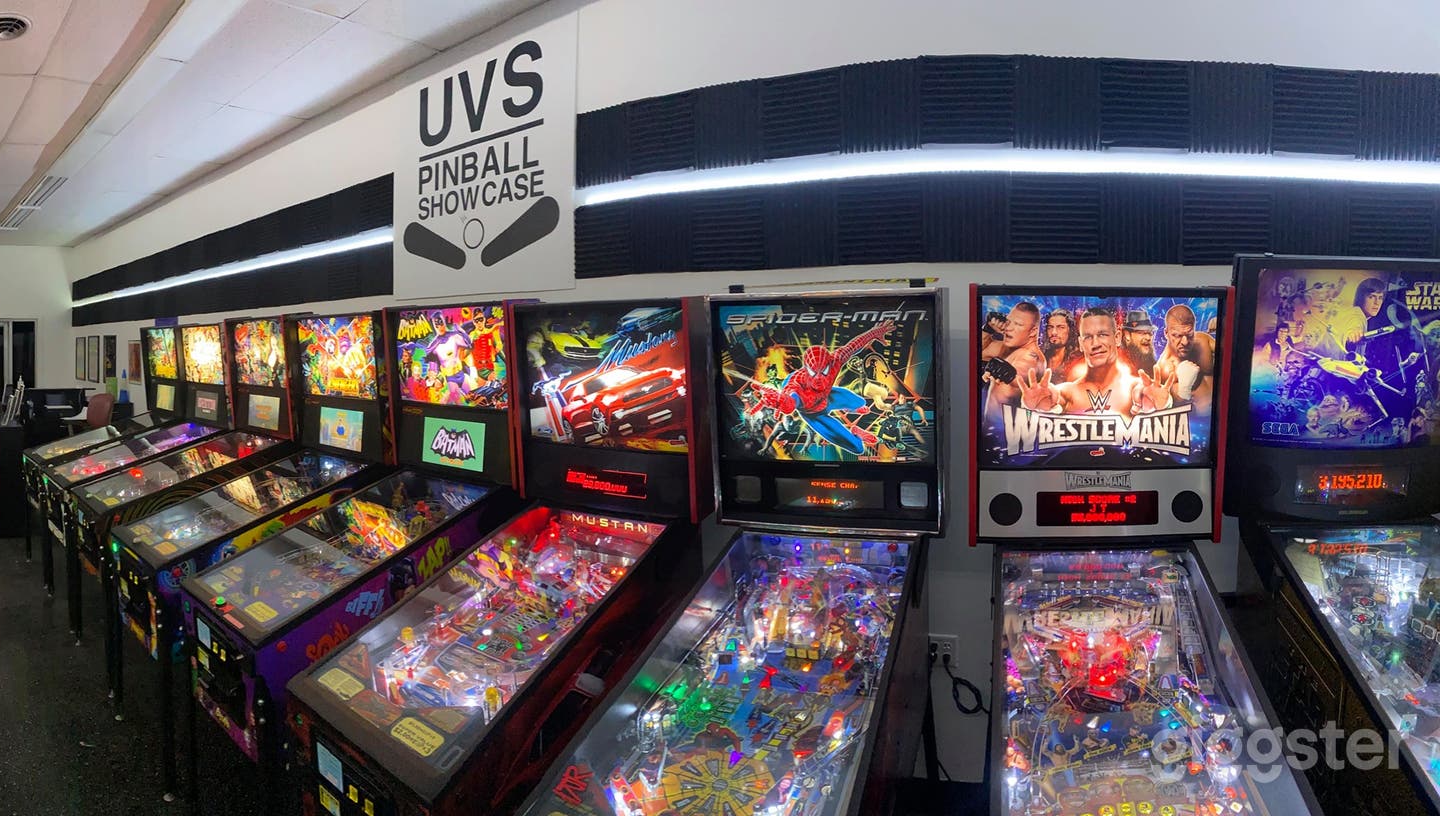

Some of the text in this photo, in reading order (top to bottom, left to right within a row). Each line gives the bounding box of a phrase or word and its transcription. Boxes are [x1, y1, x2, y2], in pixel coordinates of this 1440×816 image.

[419, 40, 543, 147] UVS
[418, 136, 540, 195] PINBALL
[418, 169, 545, 220] SHOWCASE
[397, 314, 433, 342] BATMAN
[726, 310, 926, 325] SPIDER-MAN
[431, 428, 475, 458] BATMAN
[1262, 422, 1300, 437] SEGA
